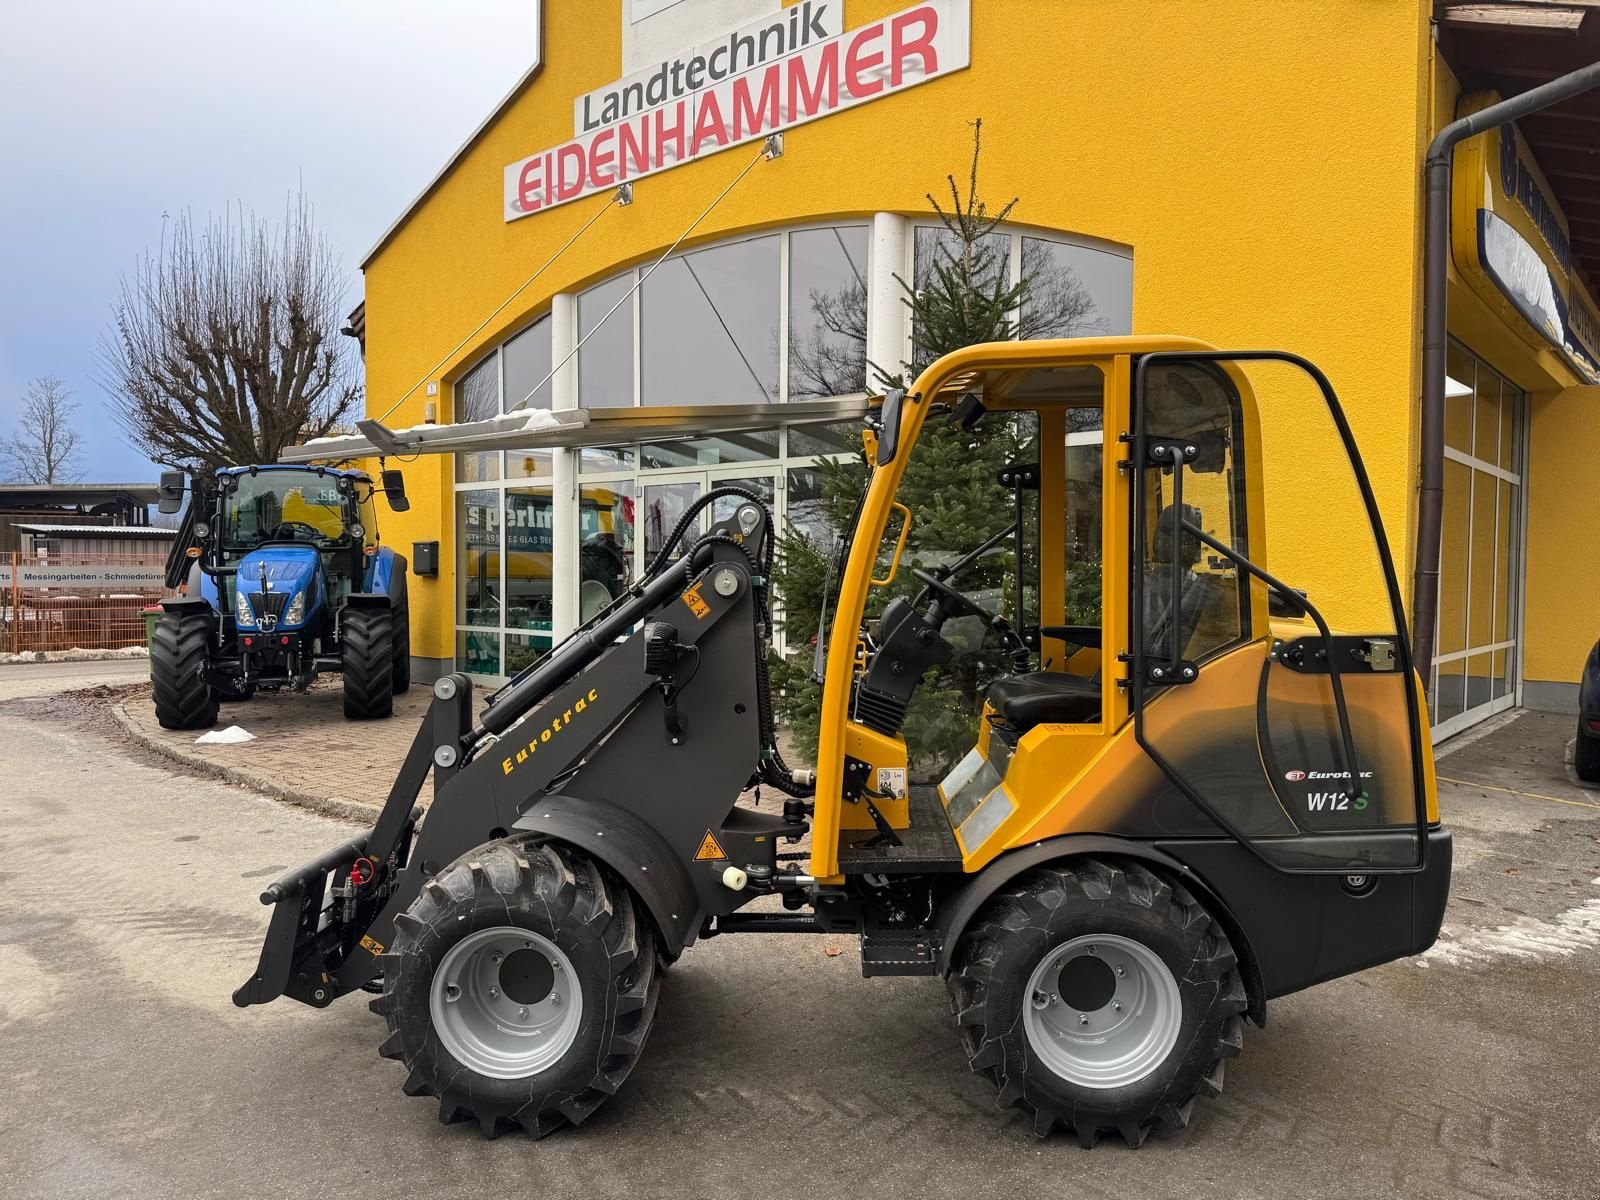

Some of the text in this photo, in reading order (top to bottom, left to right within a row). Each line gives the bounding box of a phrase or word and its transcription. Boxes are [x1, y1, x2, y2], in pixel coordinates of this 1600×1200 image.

[518, 5, 939, 213] EIDENHAMMER
[582, 0, 829, 133] Landtechnik
[24, 573, 97, 582] Messingarbeiten
[104, 572, 166, 581] Schmiedetüren
[519, 535, 538, 544] GLAS
[502, 688, 598, 775] Eurotrac
